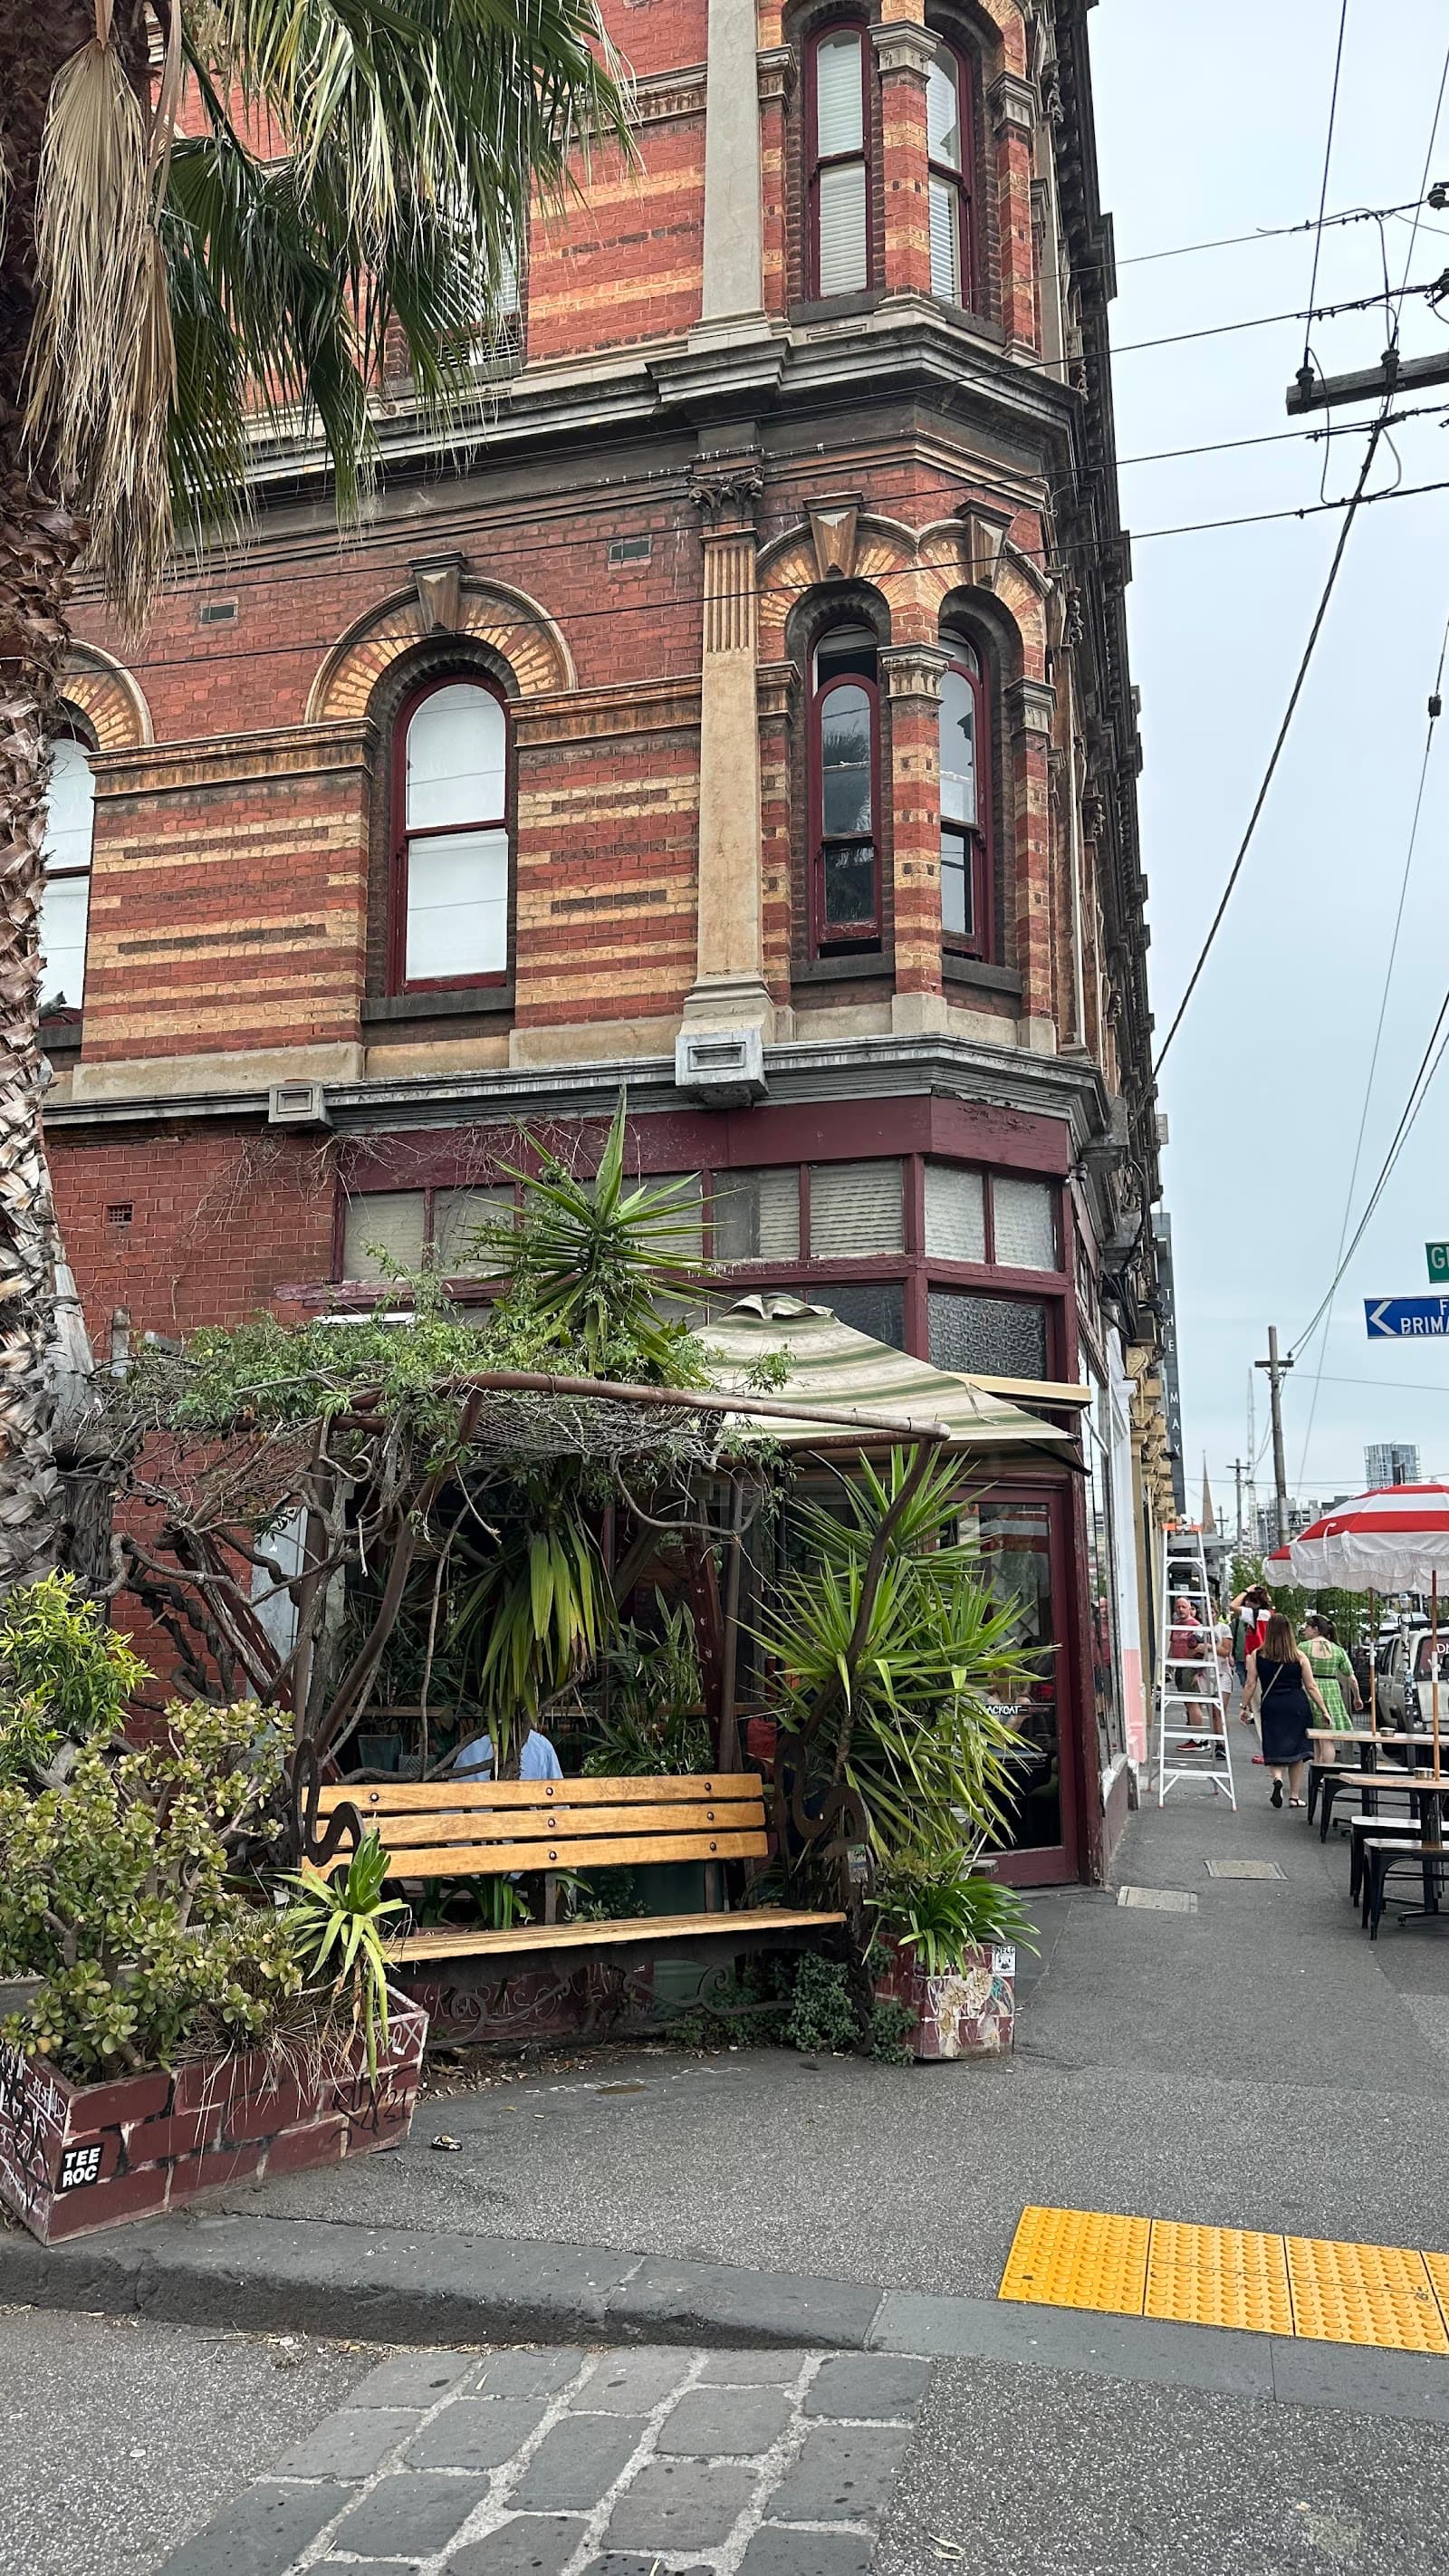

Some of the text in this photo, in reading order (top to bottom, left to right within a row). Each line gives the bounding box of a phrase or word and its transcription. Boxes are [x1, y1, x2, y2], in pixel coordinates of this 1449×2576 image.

[1431, 1246, 1449, 1269] G
[64, 2148, 101, 2169] TEE
[62, 2165, 97, 2187] ROC
